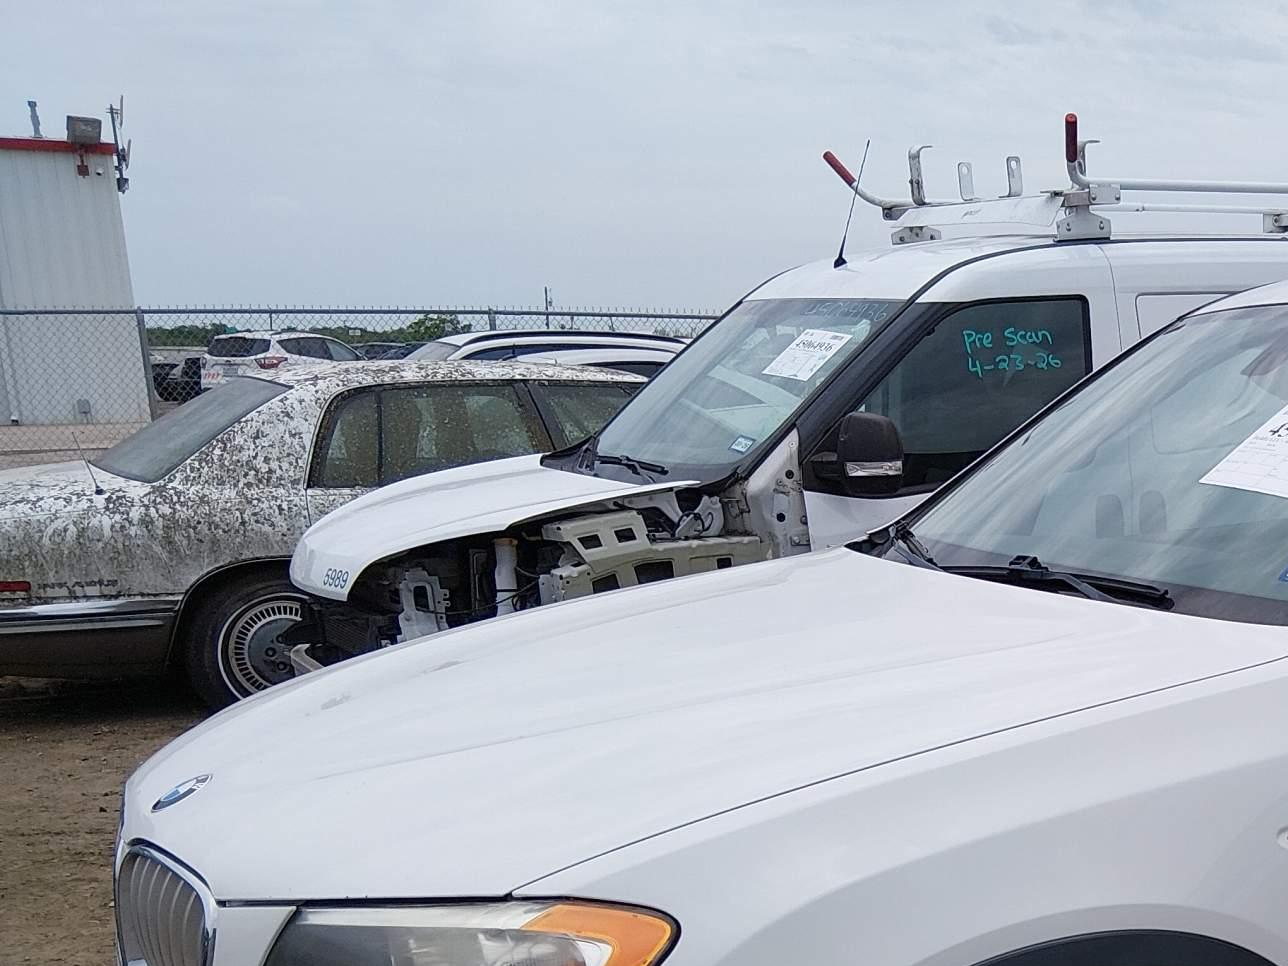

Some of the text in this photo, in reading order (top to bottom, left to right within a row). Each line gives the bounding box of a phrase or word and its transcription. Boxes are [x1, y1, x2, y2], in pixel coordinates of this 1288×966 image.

[963, 327, 1053, 354] Pre Scan
[968, 352, 1062, 377] 4-23-26
[323, 567, 349, 589] 5989
